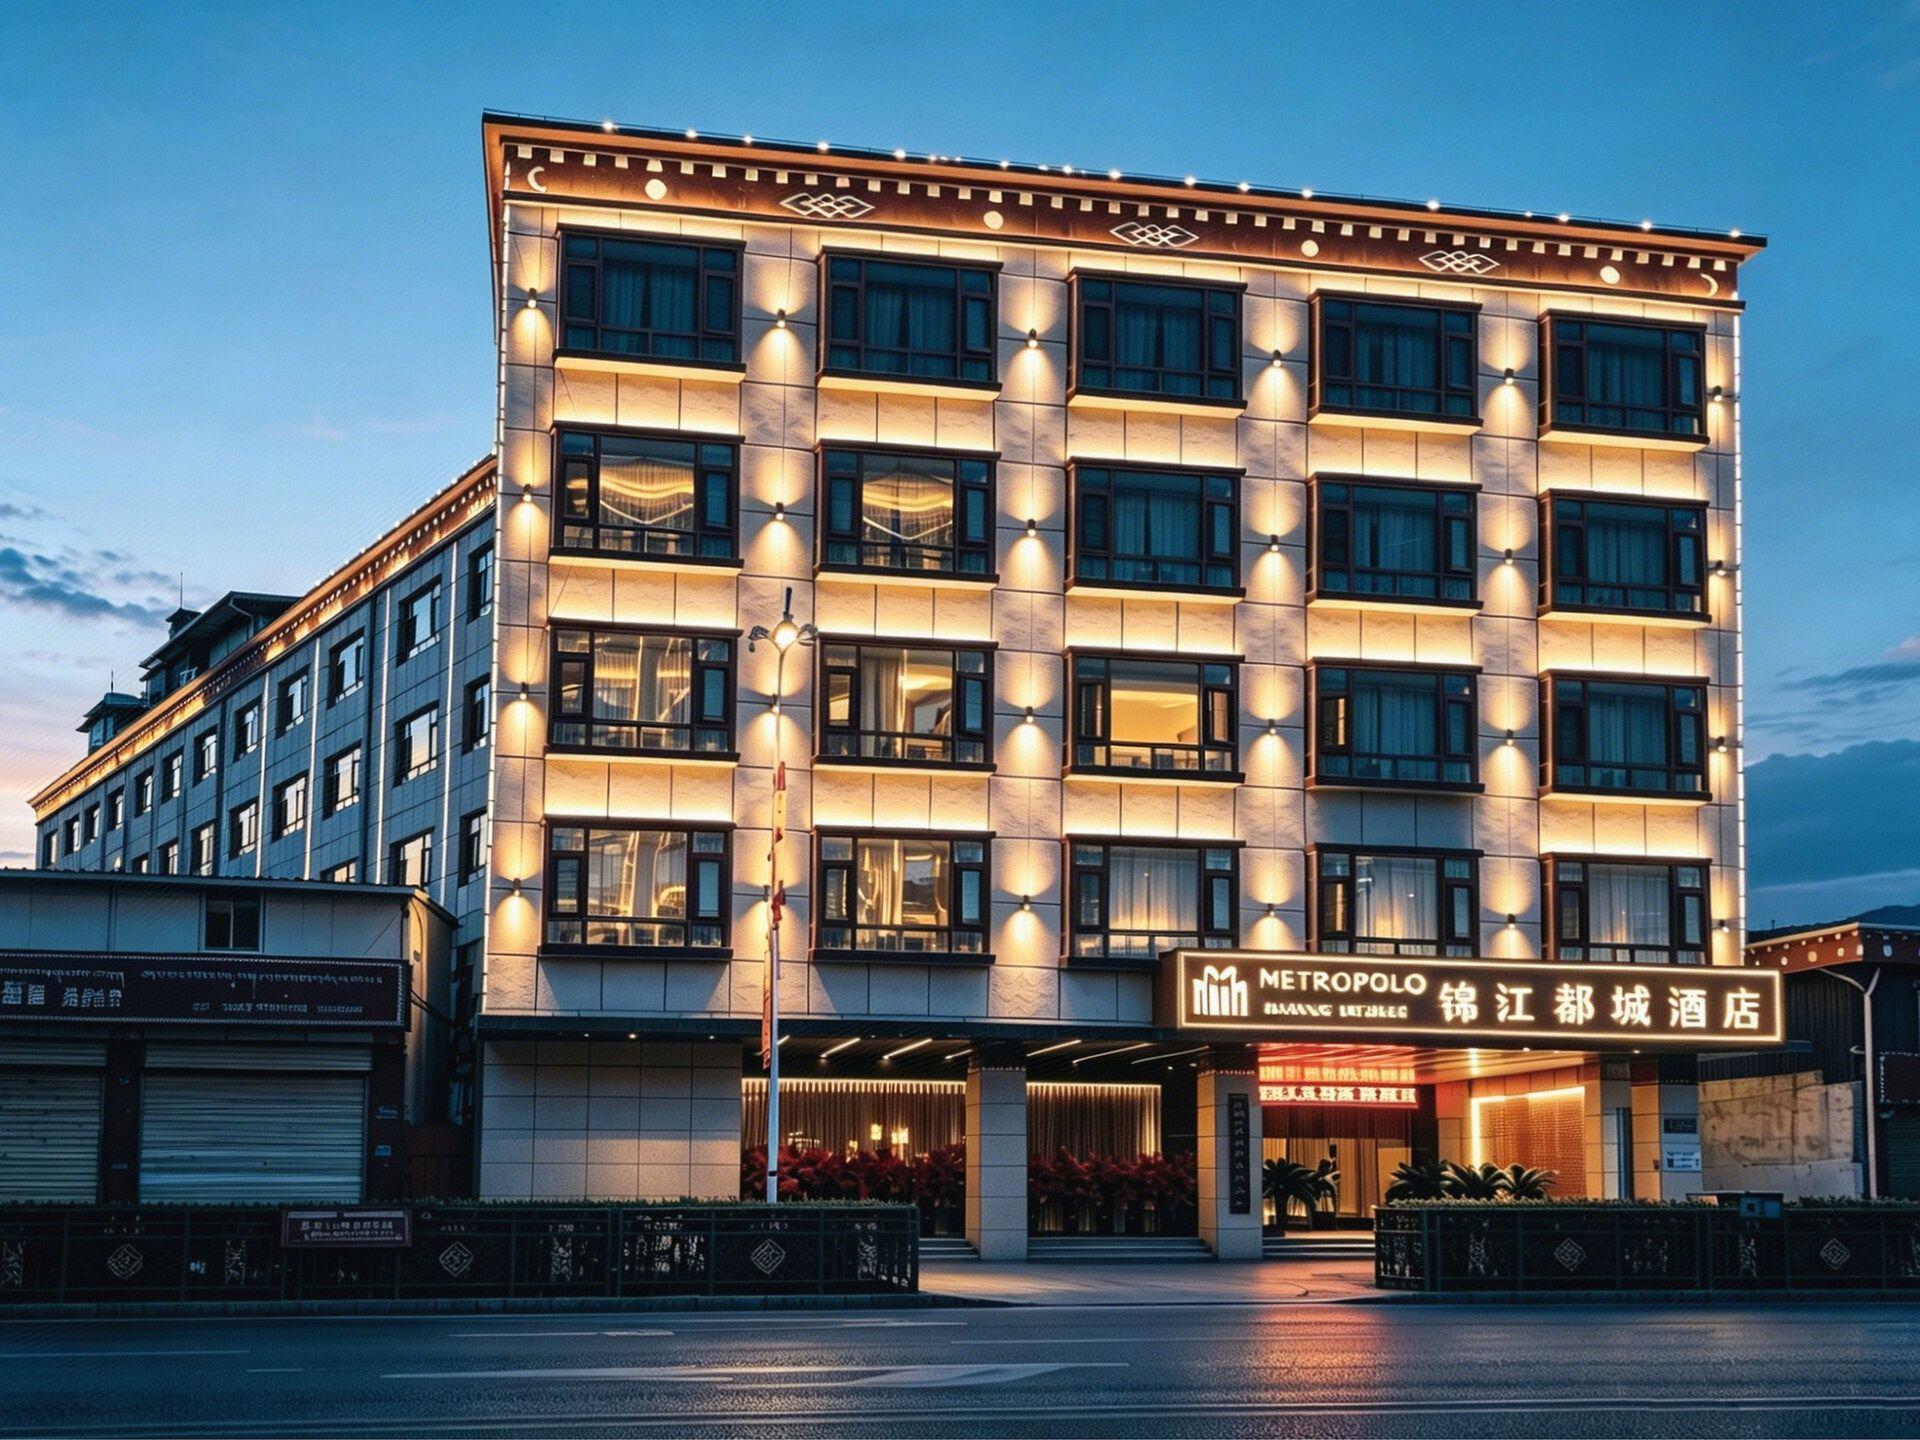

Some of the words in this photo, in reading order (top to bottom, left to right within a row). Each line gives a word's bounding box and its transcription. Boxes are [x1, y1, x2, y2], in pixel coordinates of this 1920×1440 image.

[1260, 967, 1427, 995] METROPOLO
[1438, 981, 1760, 1029] 锦江都城酒店
